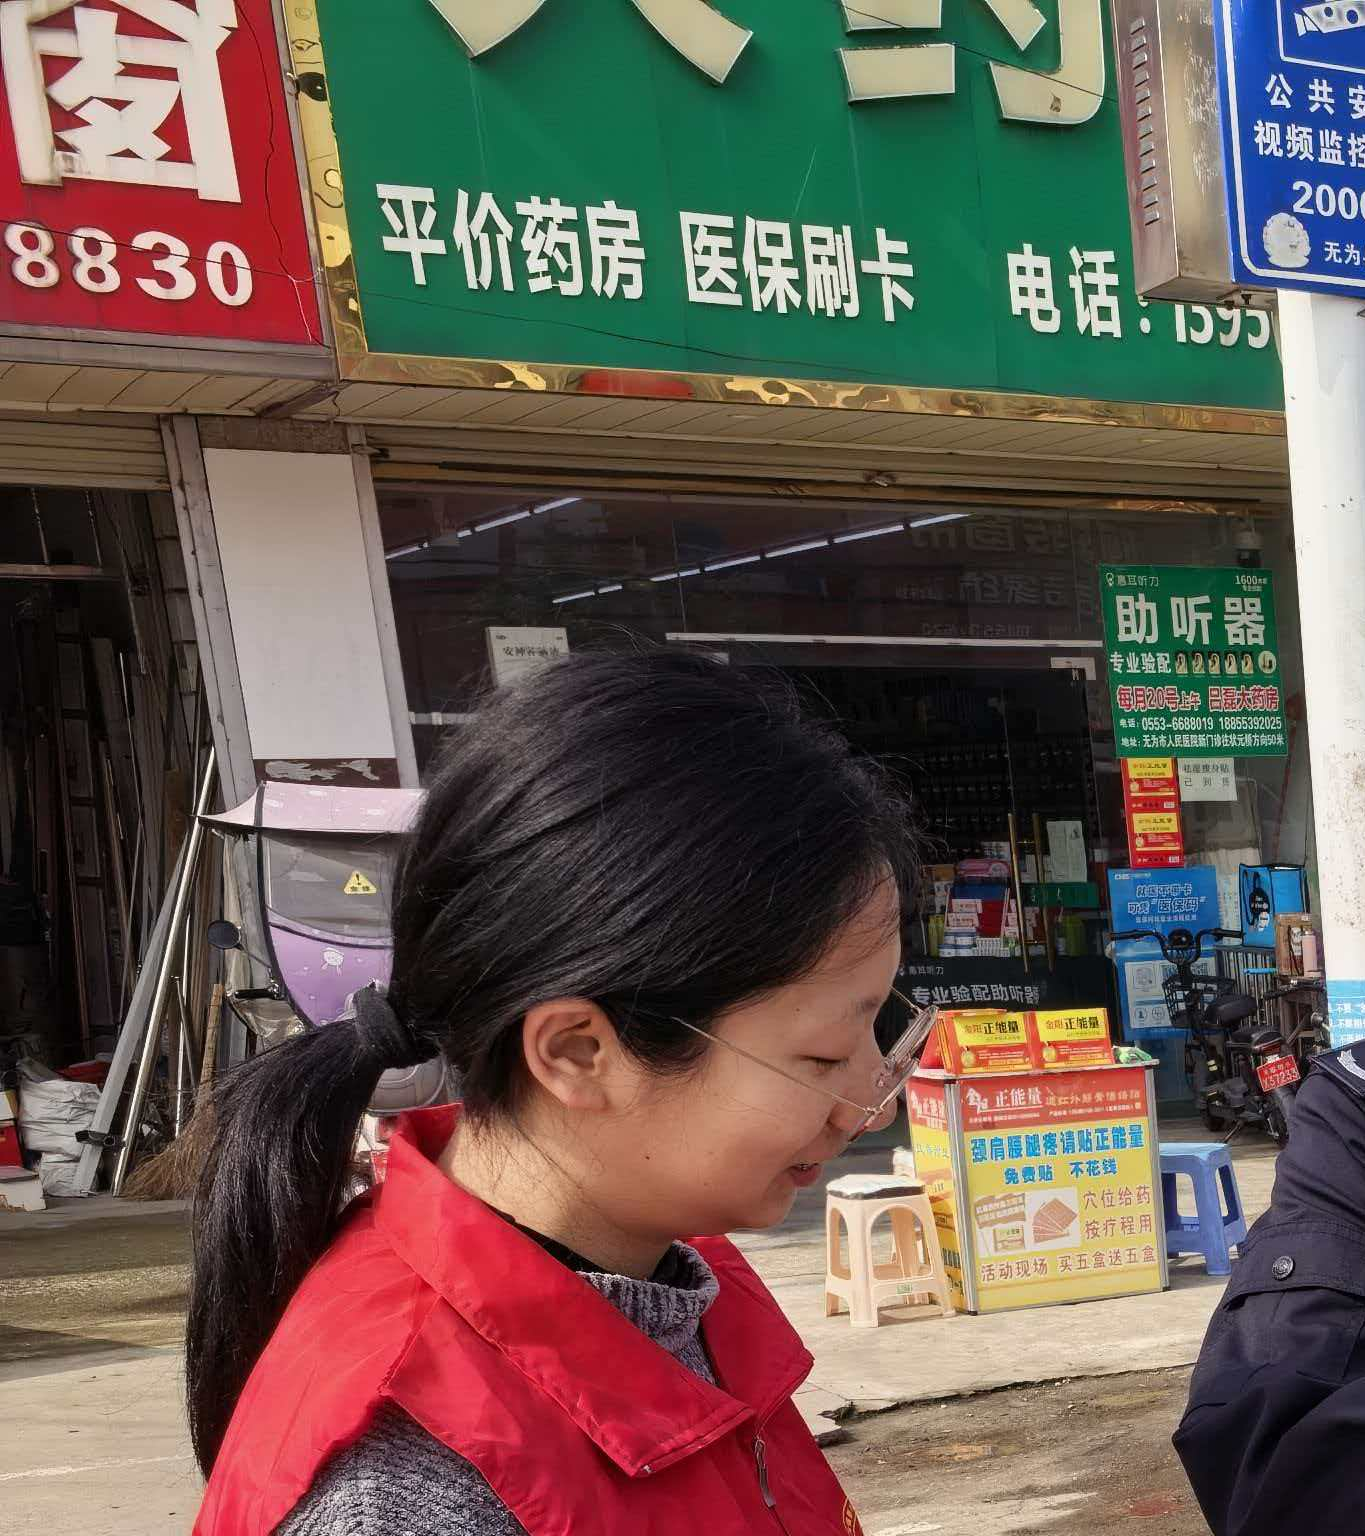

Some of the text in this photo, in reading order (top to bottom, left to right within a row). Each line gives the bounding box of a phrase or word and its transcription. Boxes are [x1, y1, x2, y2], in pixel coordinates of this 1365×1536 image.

[376, 183, 646, 301] 平价药房
[678, 210, 916, 324] 医保刷卡
[1114, 592, 1266, 646] 助听器
[1109, 651, 1172, 675] 专业验配
[1116, 684, 1202, 712] 每月20号上午
[1003, 1157, 1119, 1185] 免费贴 不花钱
[1082, 1183, 1151, 1210] 穴位给药
[1084, 1213, 1153, 1241] 按疗程用
[980, 1244, 1157, 1283] 活动现场 买五盒送五盒
